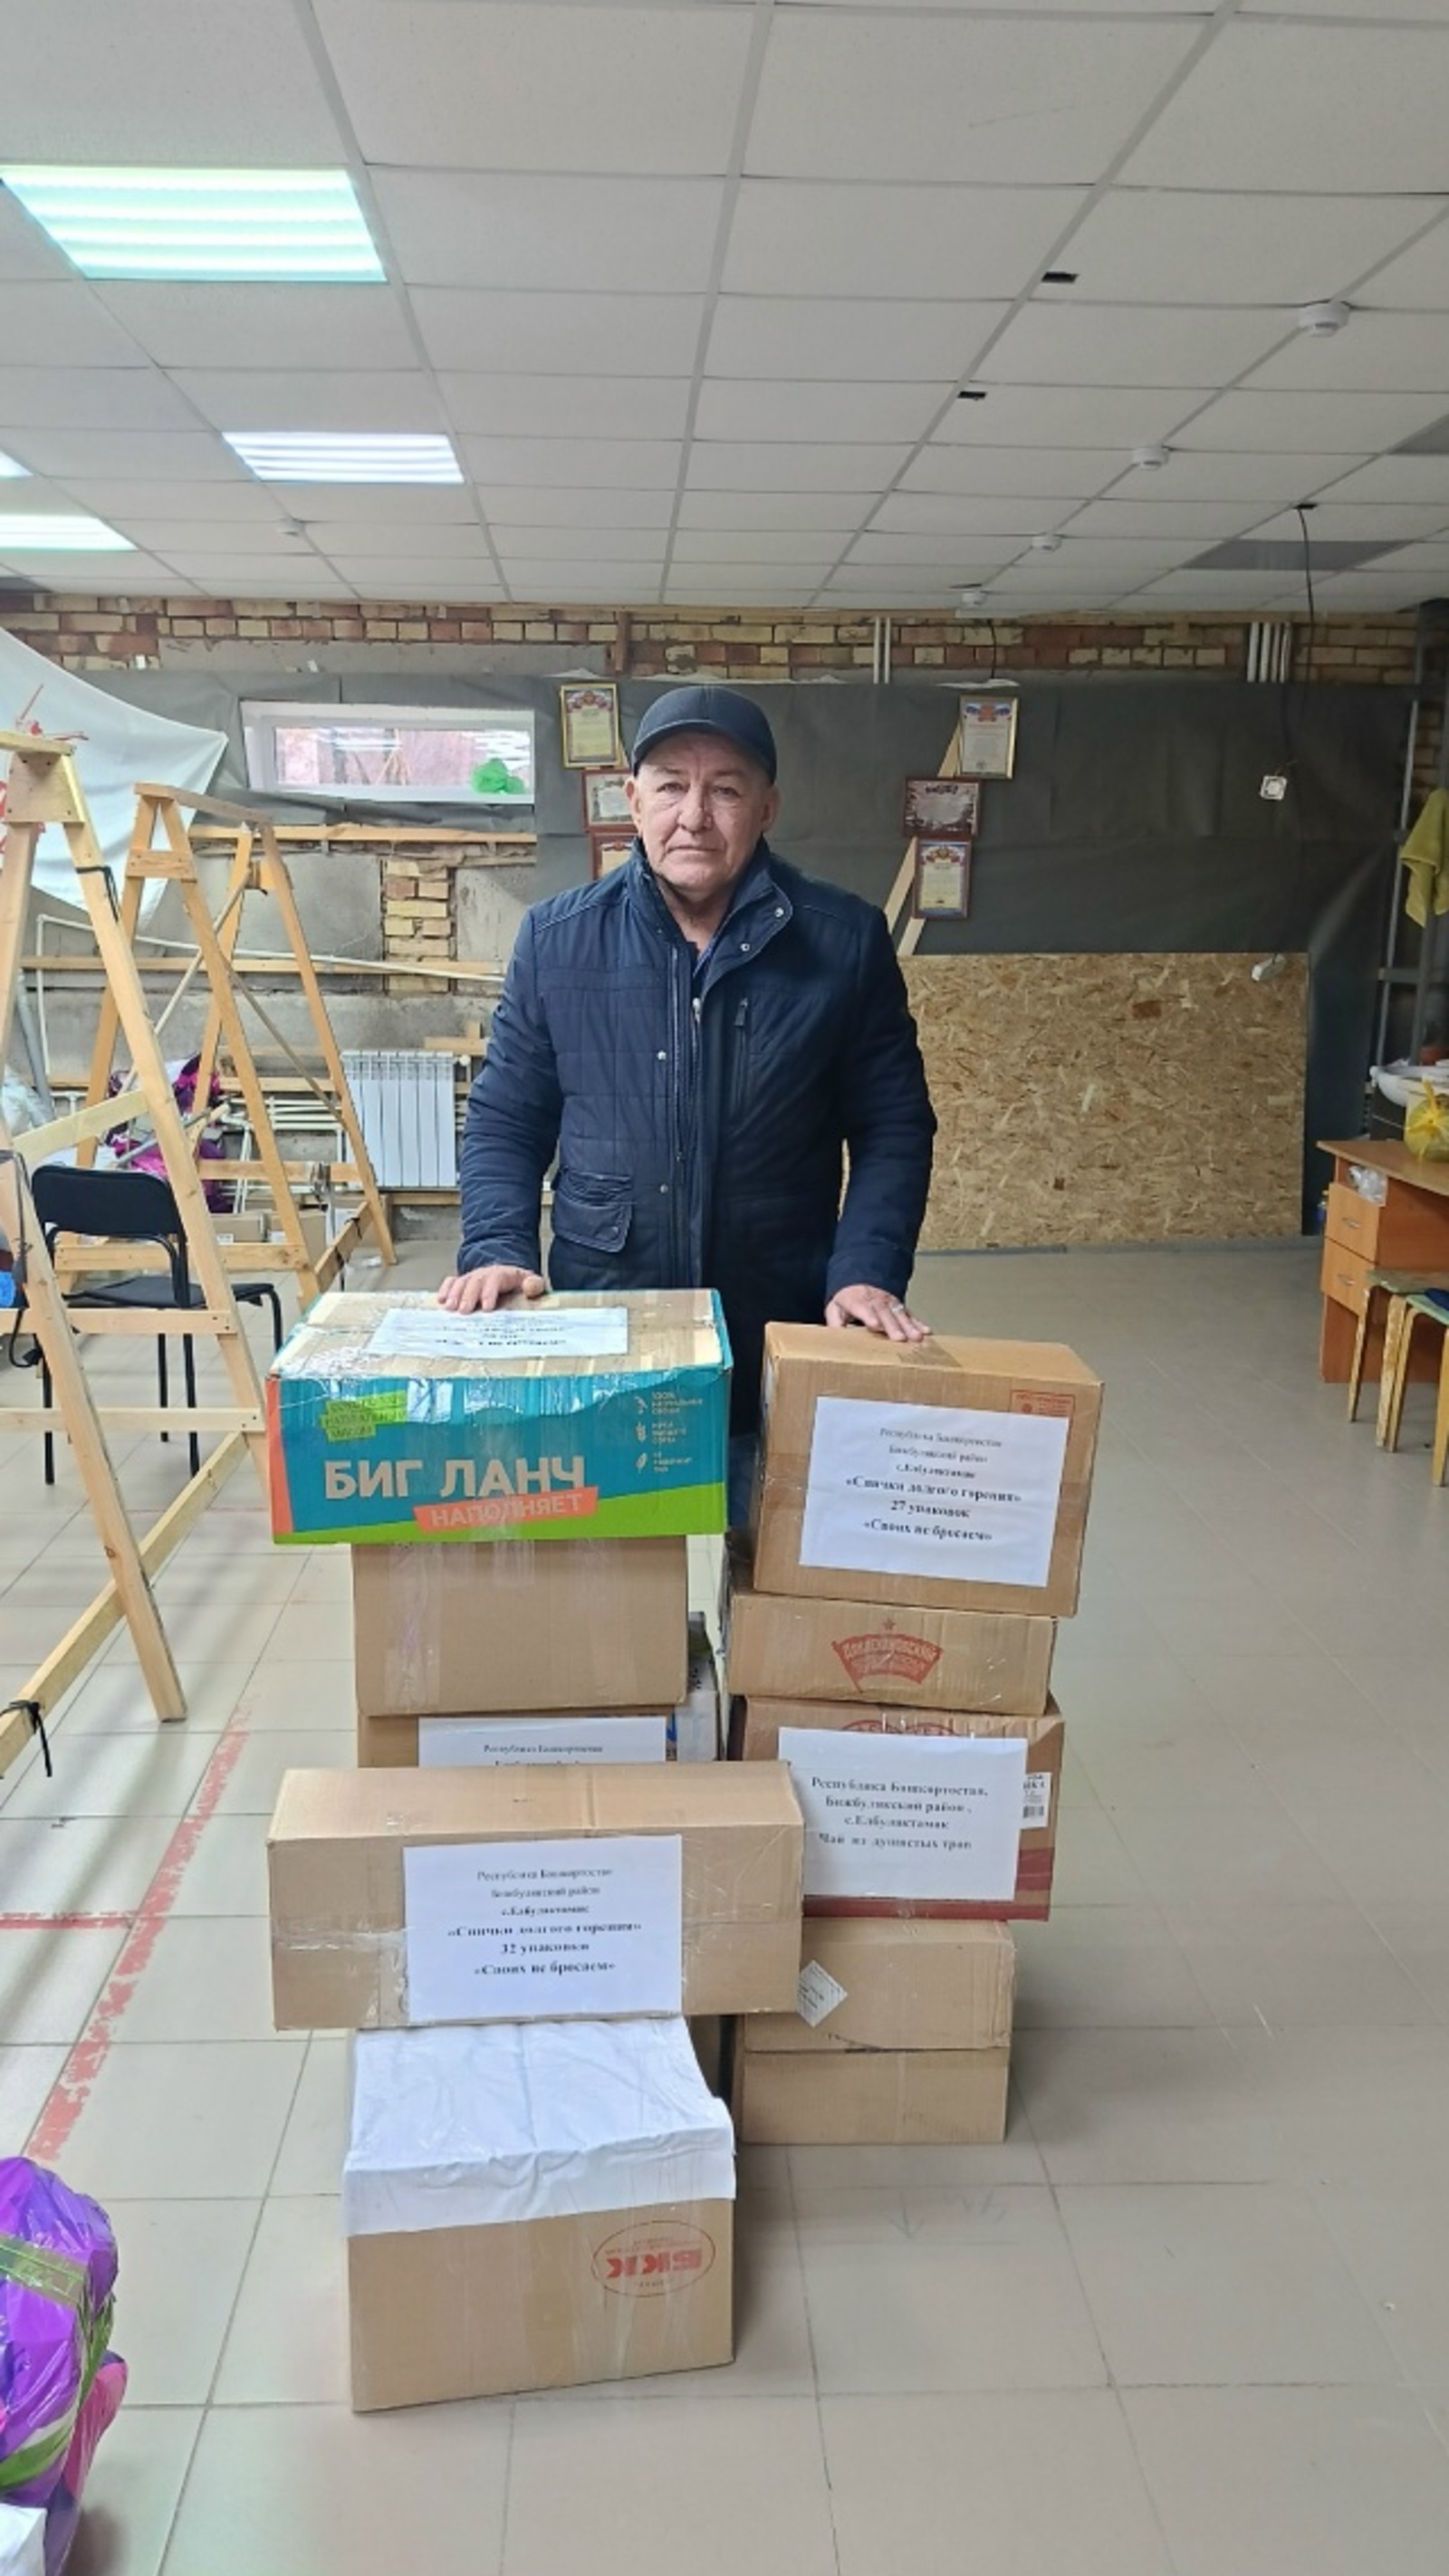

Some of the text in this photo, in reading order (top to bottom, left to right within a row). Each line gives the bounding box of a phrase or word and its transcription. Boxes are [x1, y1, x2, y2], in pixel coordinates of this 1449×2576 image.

[879, 1428, 1003, 1449] Республика Башкортостан
[959, 1452, 988, 1464] район
[324, 1454, 585, 1499] БИГ ЛАНЧ
[845, 1475, 1022, 1503] «Спички долгого горения»
[430, 1493, 583, 1527] НАПОЛНЯЕТ
[889, 1499, 972, 1518] 27 упаковок
[863, 1518, 993, 1541] «Своих не бросаем»
[811, 1776, 989, 1797] Республика Башкортостан,
[924, 1800, 965, 1815] район
[819, 1831, 973, 1852] Чай из душистых трав
[476, 1868, 615, 1882] Республика Башкортостан
[567, 1885, 601, 1899] район
[446, 1921, 642, 1938] «Спички долгого горения»
[501, 1943, 517, 1955] 32
[473, 1959, 617, 1977] «Своих не бросаем»
